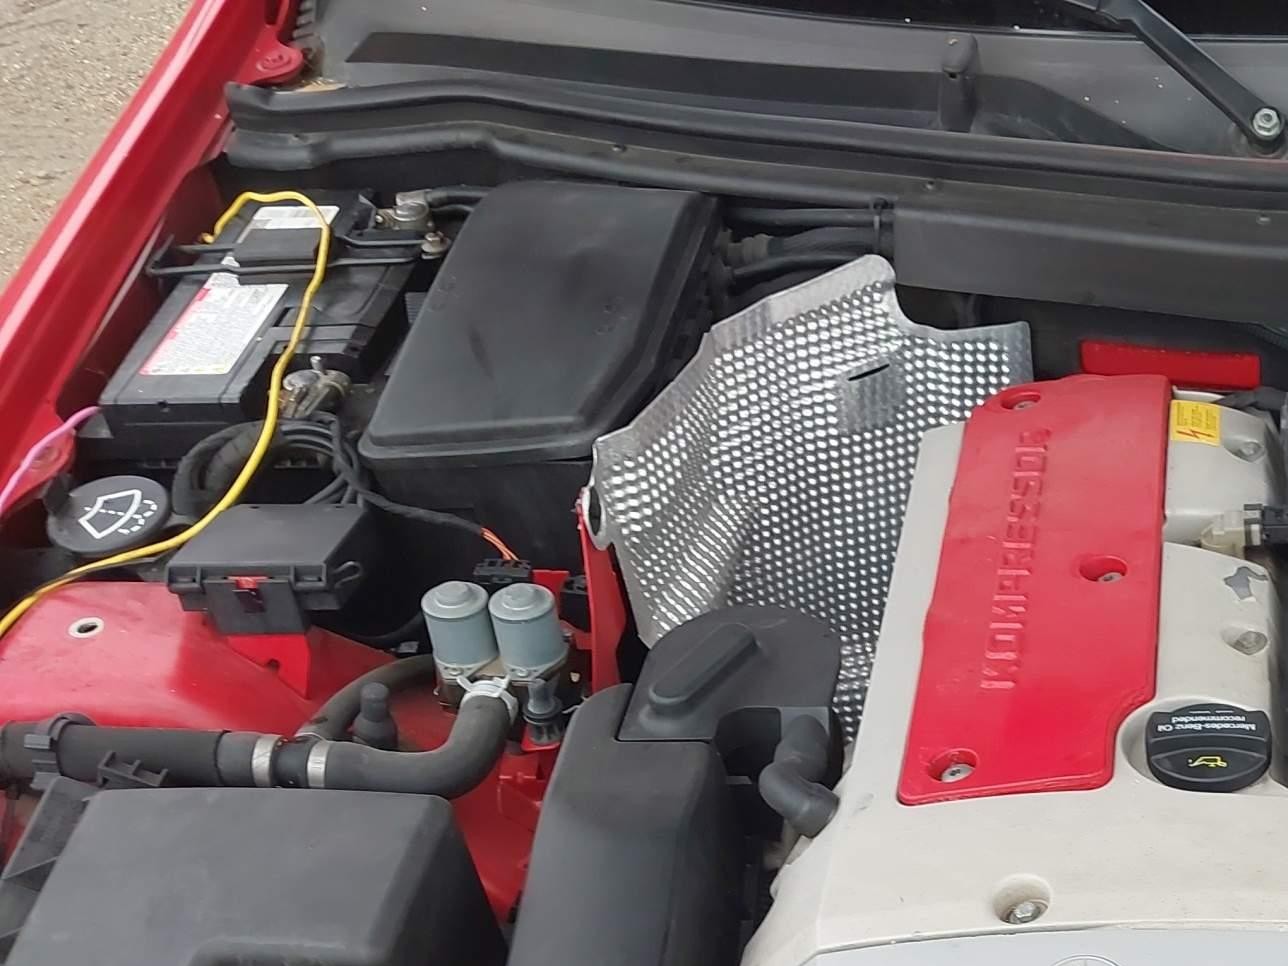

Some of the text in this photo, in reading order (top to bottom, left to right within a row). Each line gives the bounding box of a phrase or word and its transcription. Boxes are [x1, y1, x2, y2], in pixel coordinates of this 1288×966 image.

[980, 429, 1051, 690] KOMPRESSOR
[1171, 715, 1246, 724] recommended
[1157, 723, 1257, 732] Mercedes-Benz Oil
